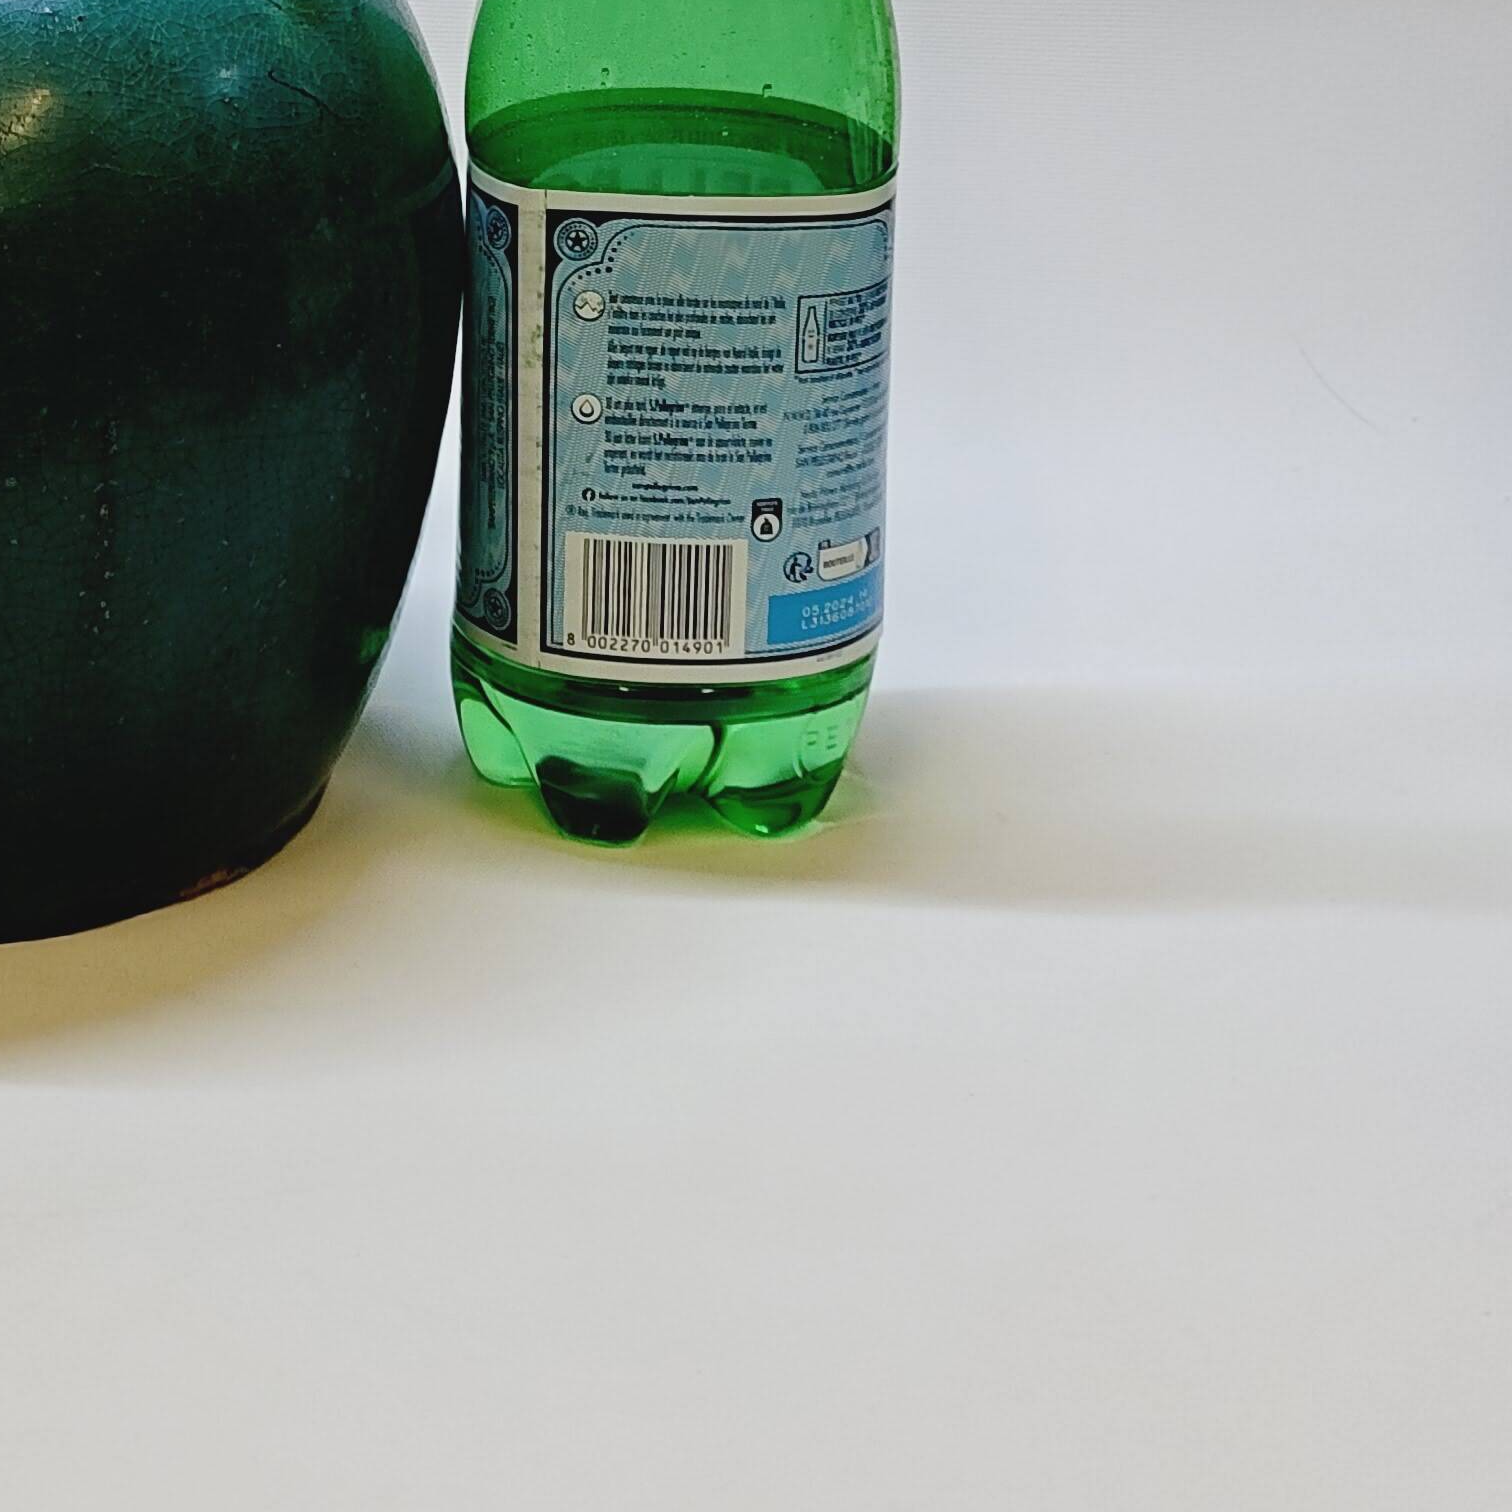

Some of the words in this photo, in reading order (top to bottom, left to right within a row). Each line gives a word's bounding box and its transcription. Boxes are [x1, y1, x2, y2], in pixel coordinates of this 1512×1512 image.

[567, 632, 576, 646] 8
[587, 635, 651, 653] 002270
[660, 640, 724, 655] 014901
